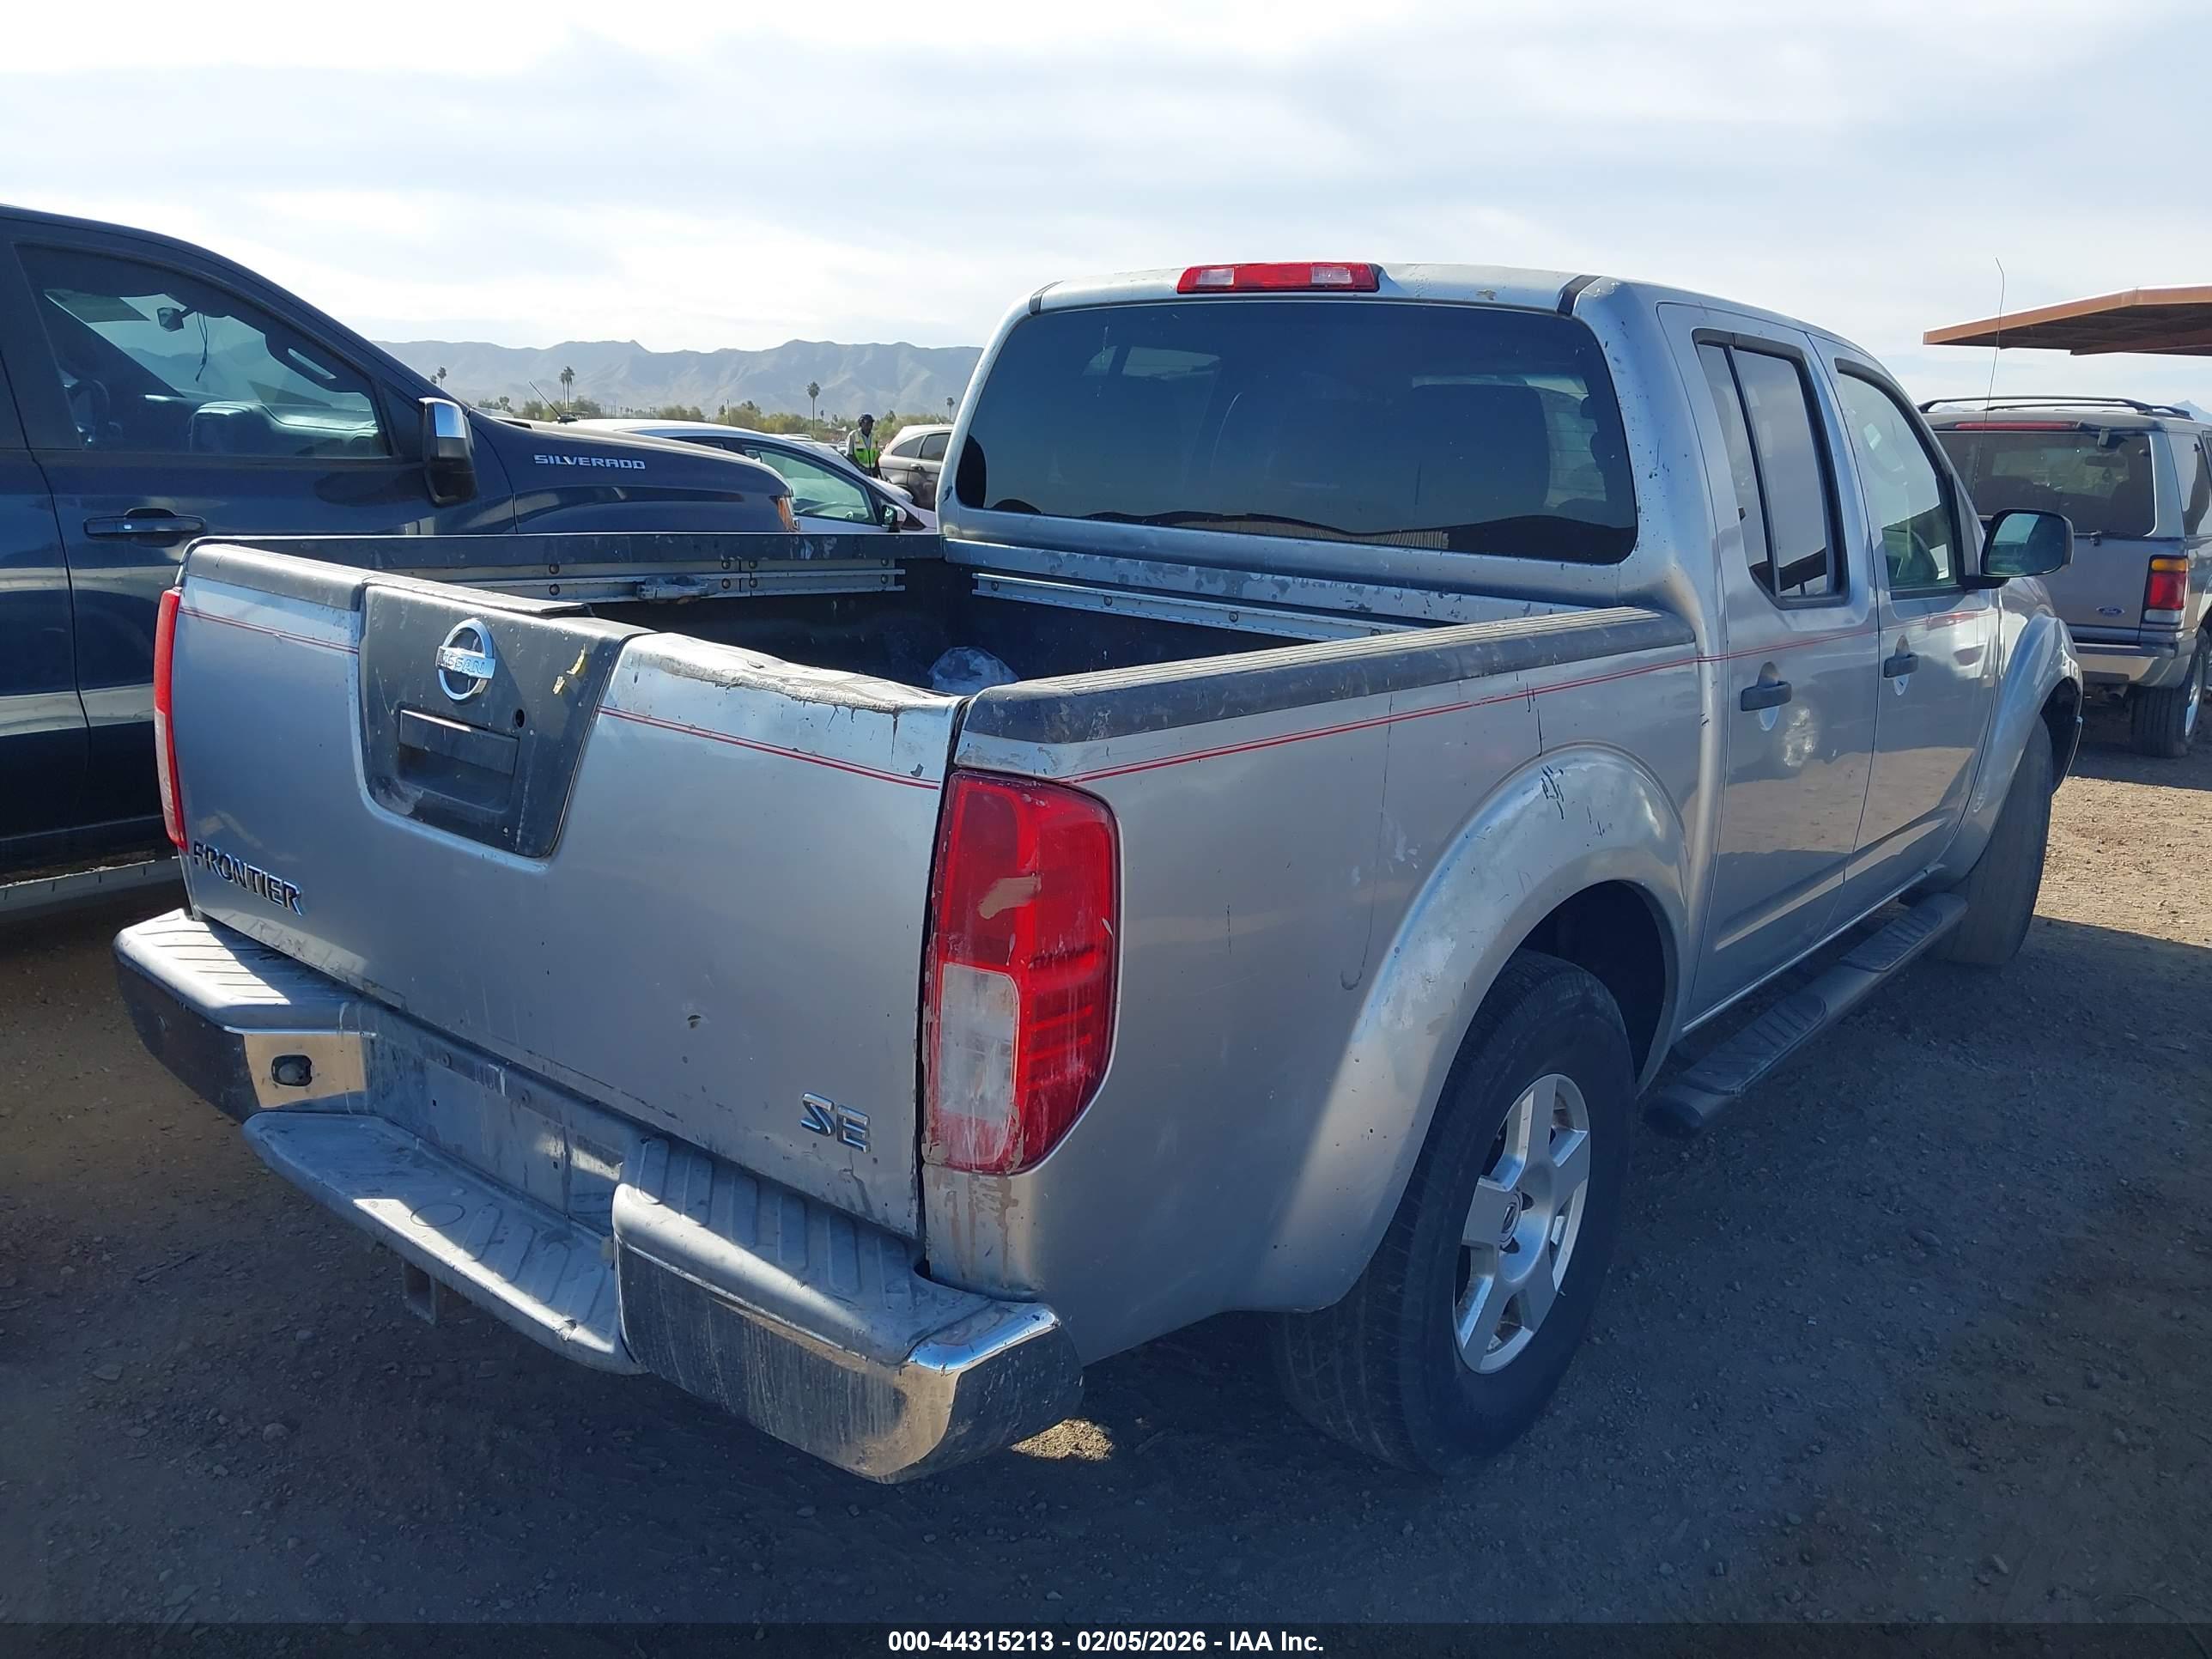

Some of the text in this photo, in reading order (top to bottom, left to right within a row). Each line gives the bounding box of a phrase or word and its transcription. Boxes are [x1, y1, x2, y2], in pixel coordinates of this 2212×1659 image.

[533, 453, 646, 470] SILVERADO
[193, 839, 302, 916] FRONTIER
[800, 1091, 871, 1154] SE
